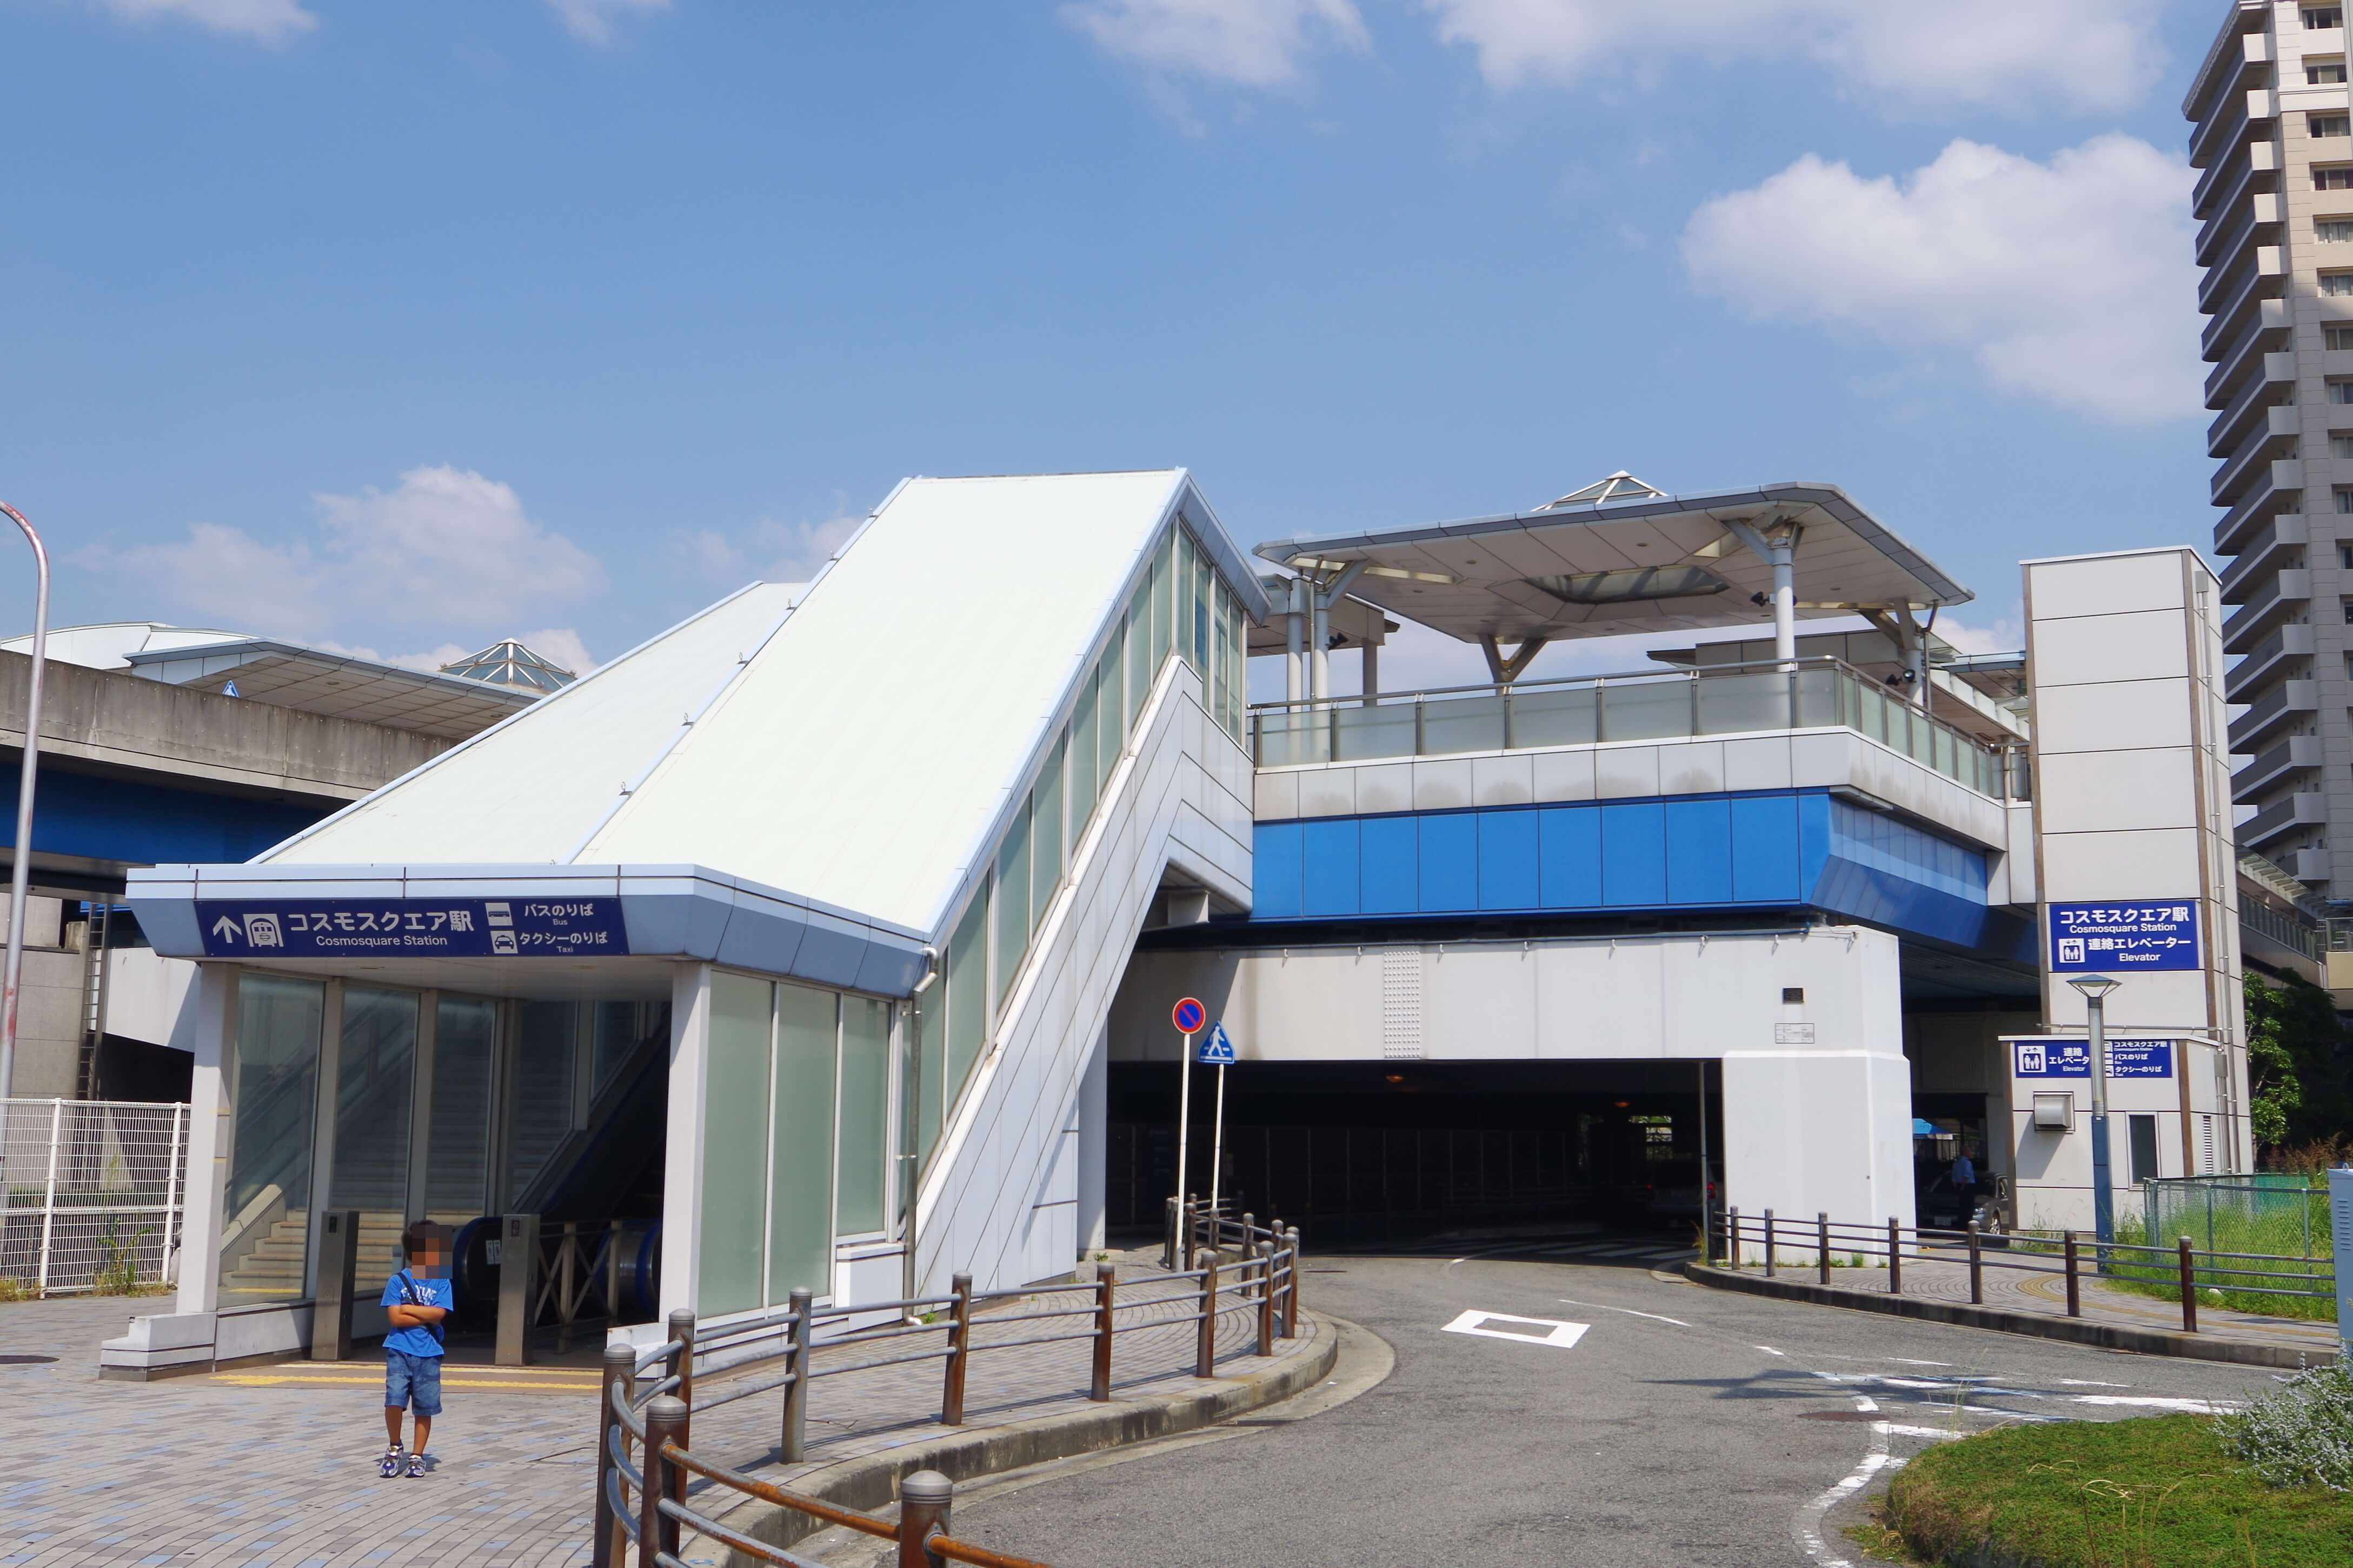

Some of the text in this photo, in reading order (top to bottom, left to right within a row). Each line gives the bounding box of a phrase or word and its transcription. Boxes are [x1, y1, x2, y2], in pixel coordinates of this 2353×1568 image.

[524, 903, 594, 917] バスのりば
[2060, 906, 2190, 924] コスモスクエア駅
[288, 910, 474, 932] コスモスクエア駅
[2069, 923, 2177, 933] Cosmosquare Station
[316, 935, 448, 948] Cosmosquare Station
[520, 931, 608, 945] タクシーのりば
[2088, 937, 2191, 950] 連絡エレベーター
[2119, 953, 2161, 962] Elevator
[2049, 1056, 2090, 1064] エレベータ
